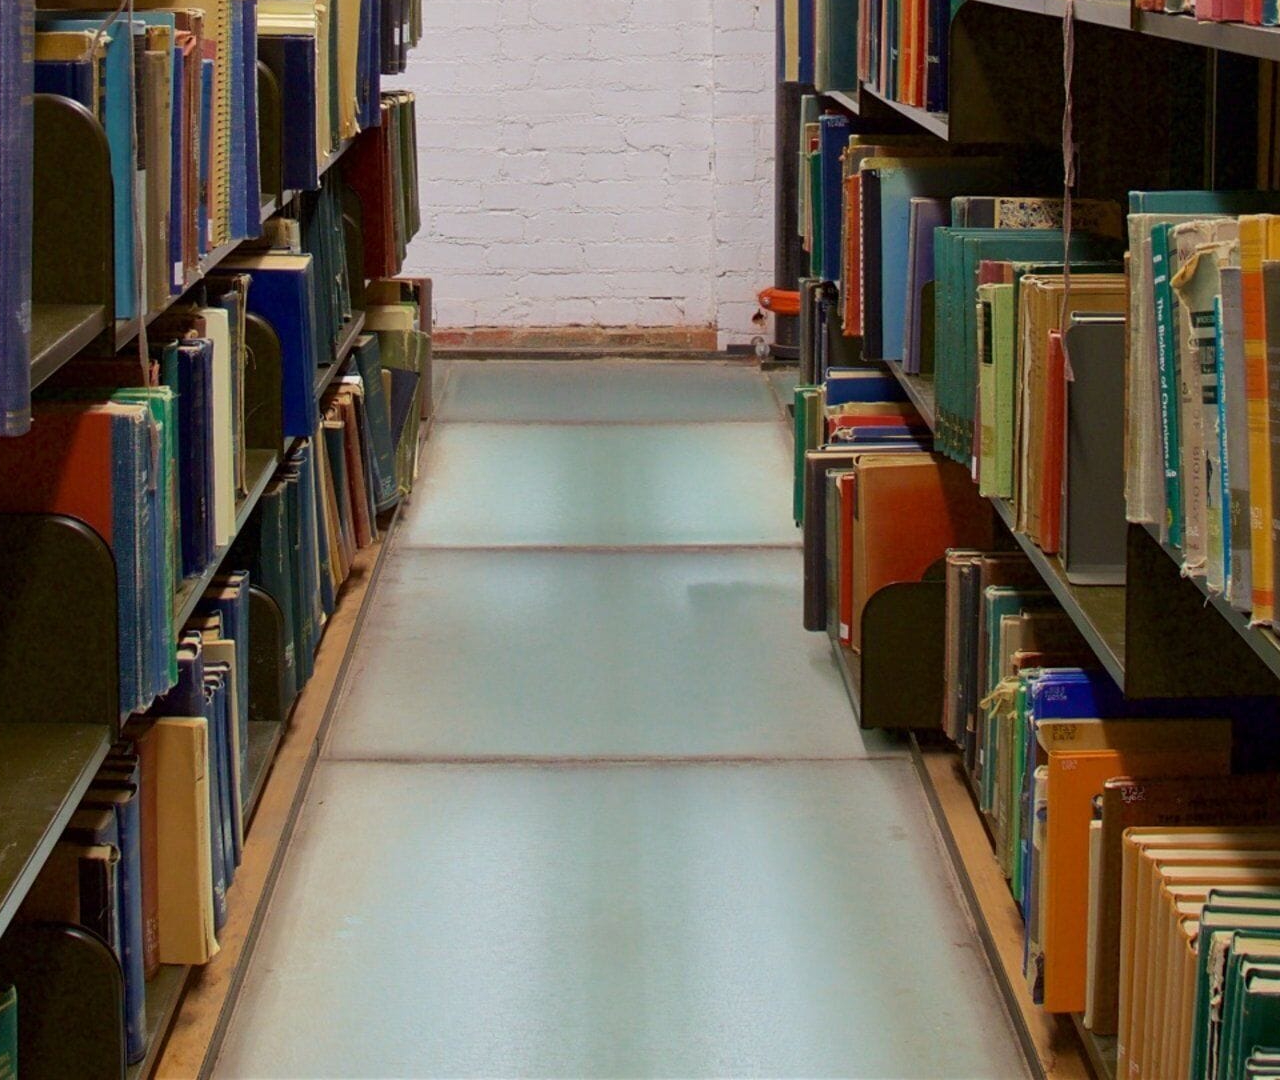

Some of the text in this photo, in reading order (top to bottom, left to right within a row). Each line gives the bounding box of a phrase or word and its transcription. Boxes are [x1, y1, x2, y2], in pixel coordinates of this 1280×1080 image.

[1156, 297, 1164, 322] The
[1157, 324, 1166, 372] Biology
[1160, 376, 1167, 390] of
